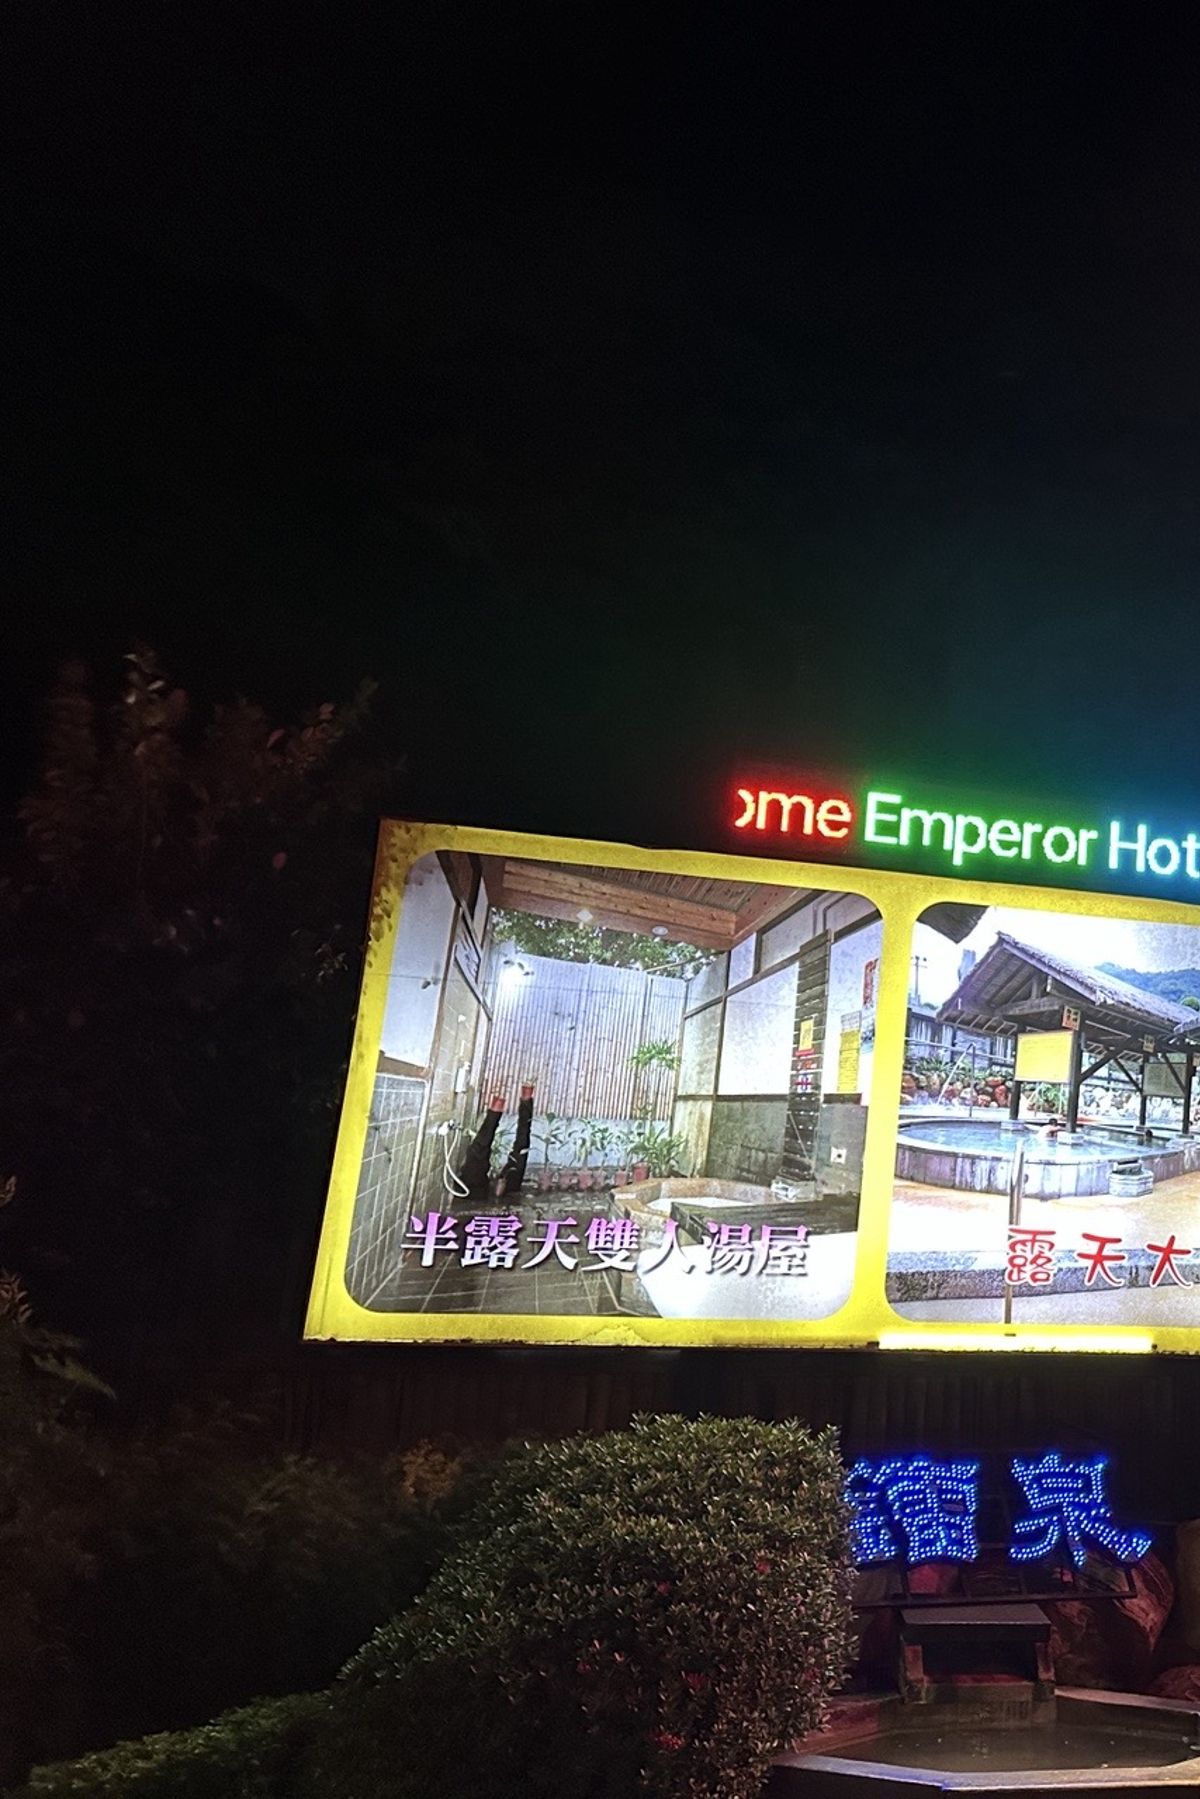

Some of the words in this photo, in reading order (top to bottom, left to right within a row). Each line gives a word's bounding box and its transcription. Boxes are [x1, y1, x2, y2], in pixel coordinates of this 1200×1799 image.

[864, 791, 1099, 866] Emperor
[400, 1211, 812, 1277] 半露天雙人湯屋
